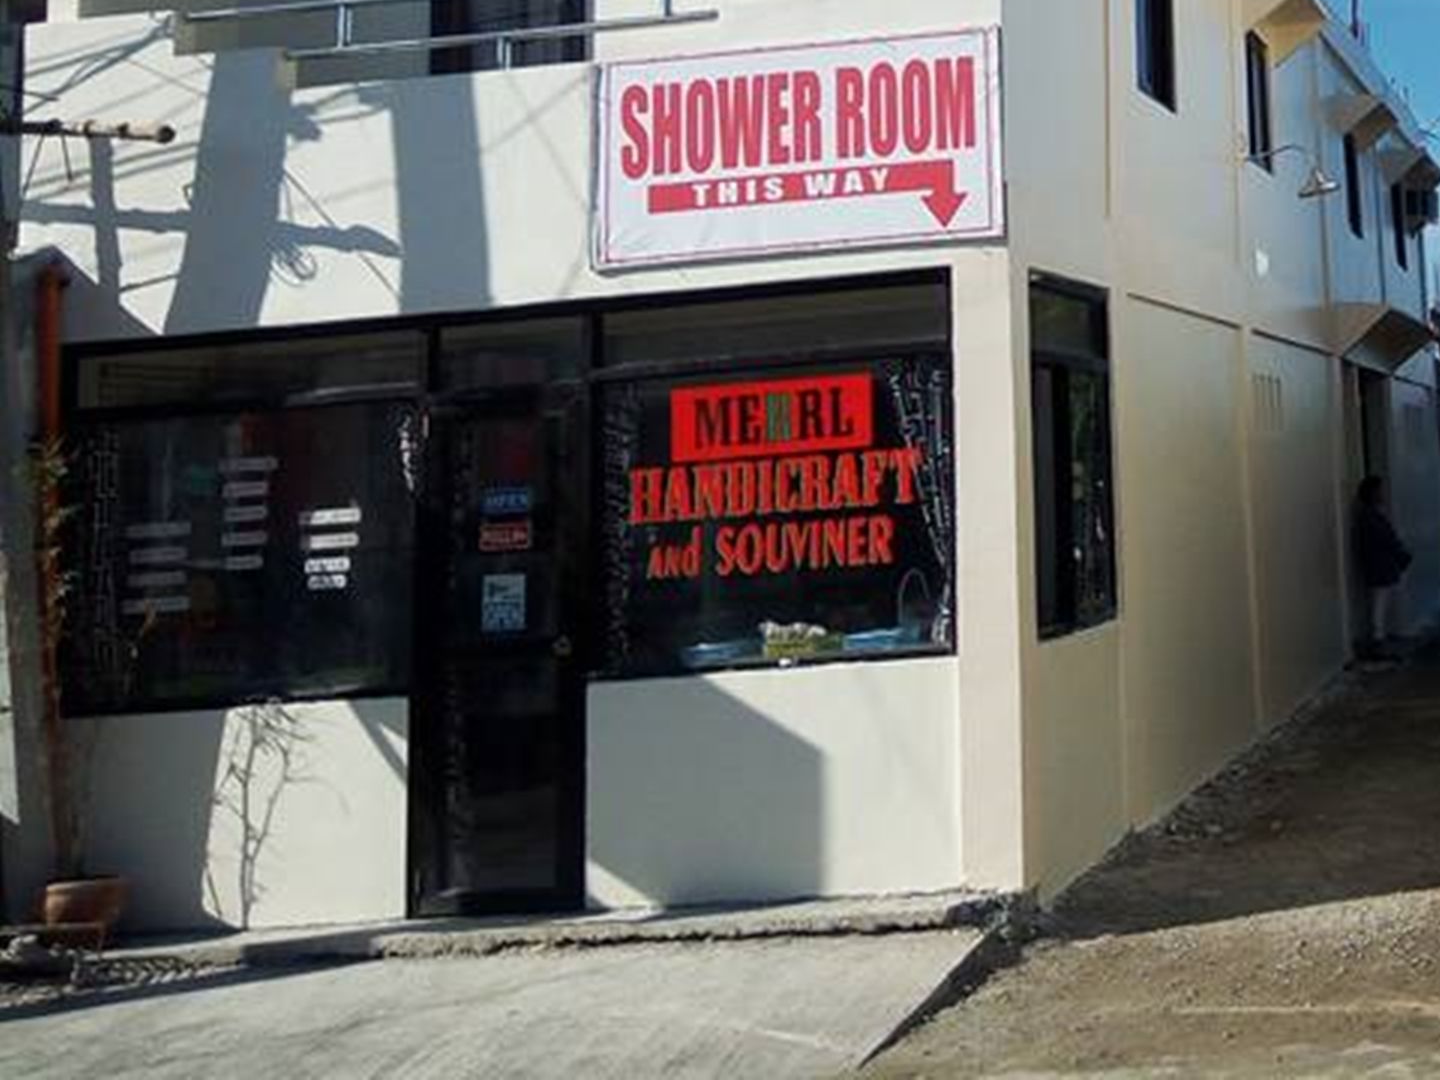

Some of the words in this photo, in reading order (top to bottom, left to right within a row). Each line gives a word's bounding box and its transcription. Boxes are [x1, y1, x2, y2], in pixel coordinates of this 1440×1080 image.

[620, 69, 822, 180] SHOWER
[835, 56, 976, 159] ROOM
[692, 176, 786, 207] THIS
[804, 166, 892, 199] WAY
[628, 447, 924, 525] HANDICRAFT
[715, 514, 895, 577] SOUVINER
